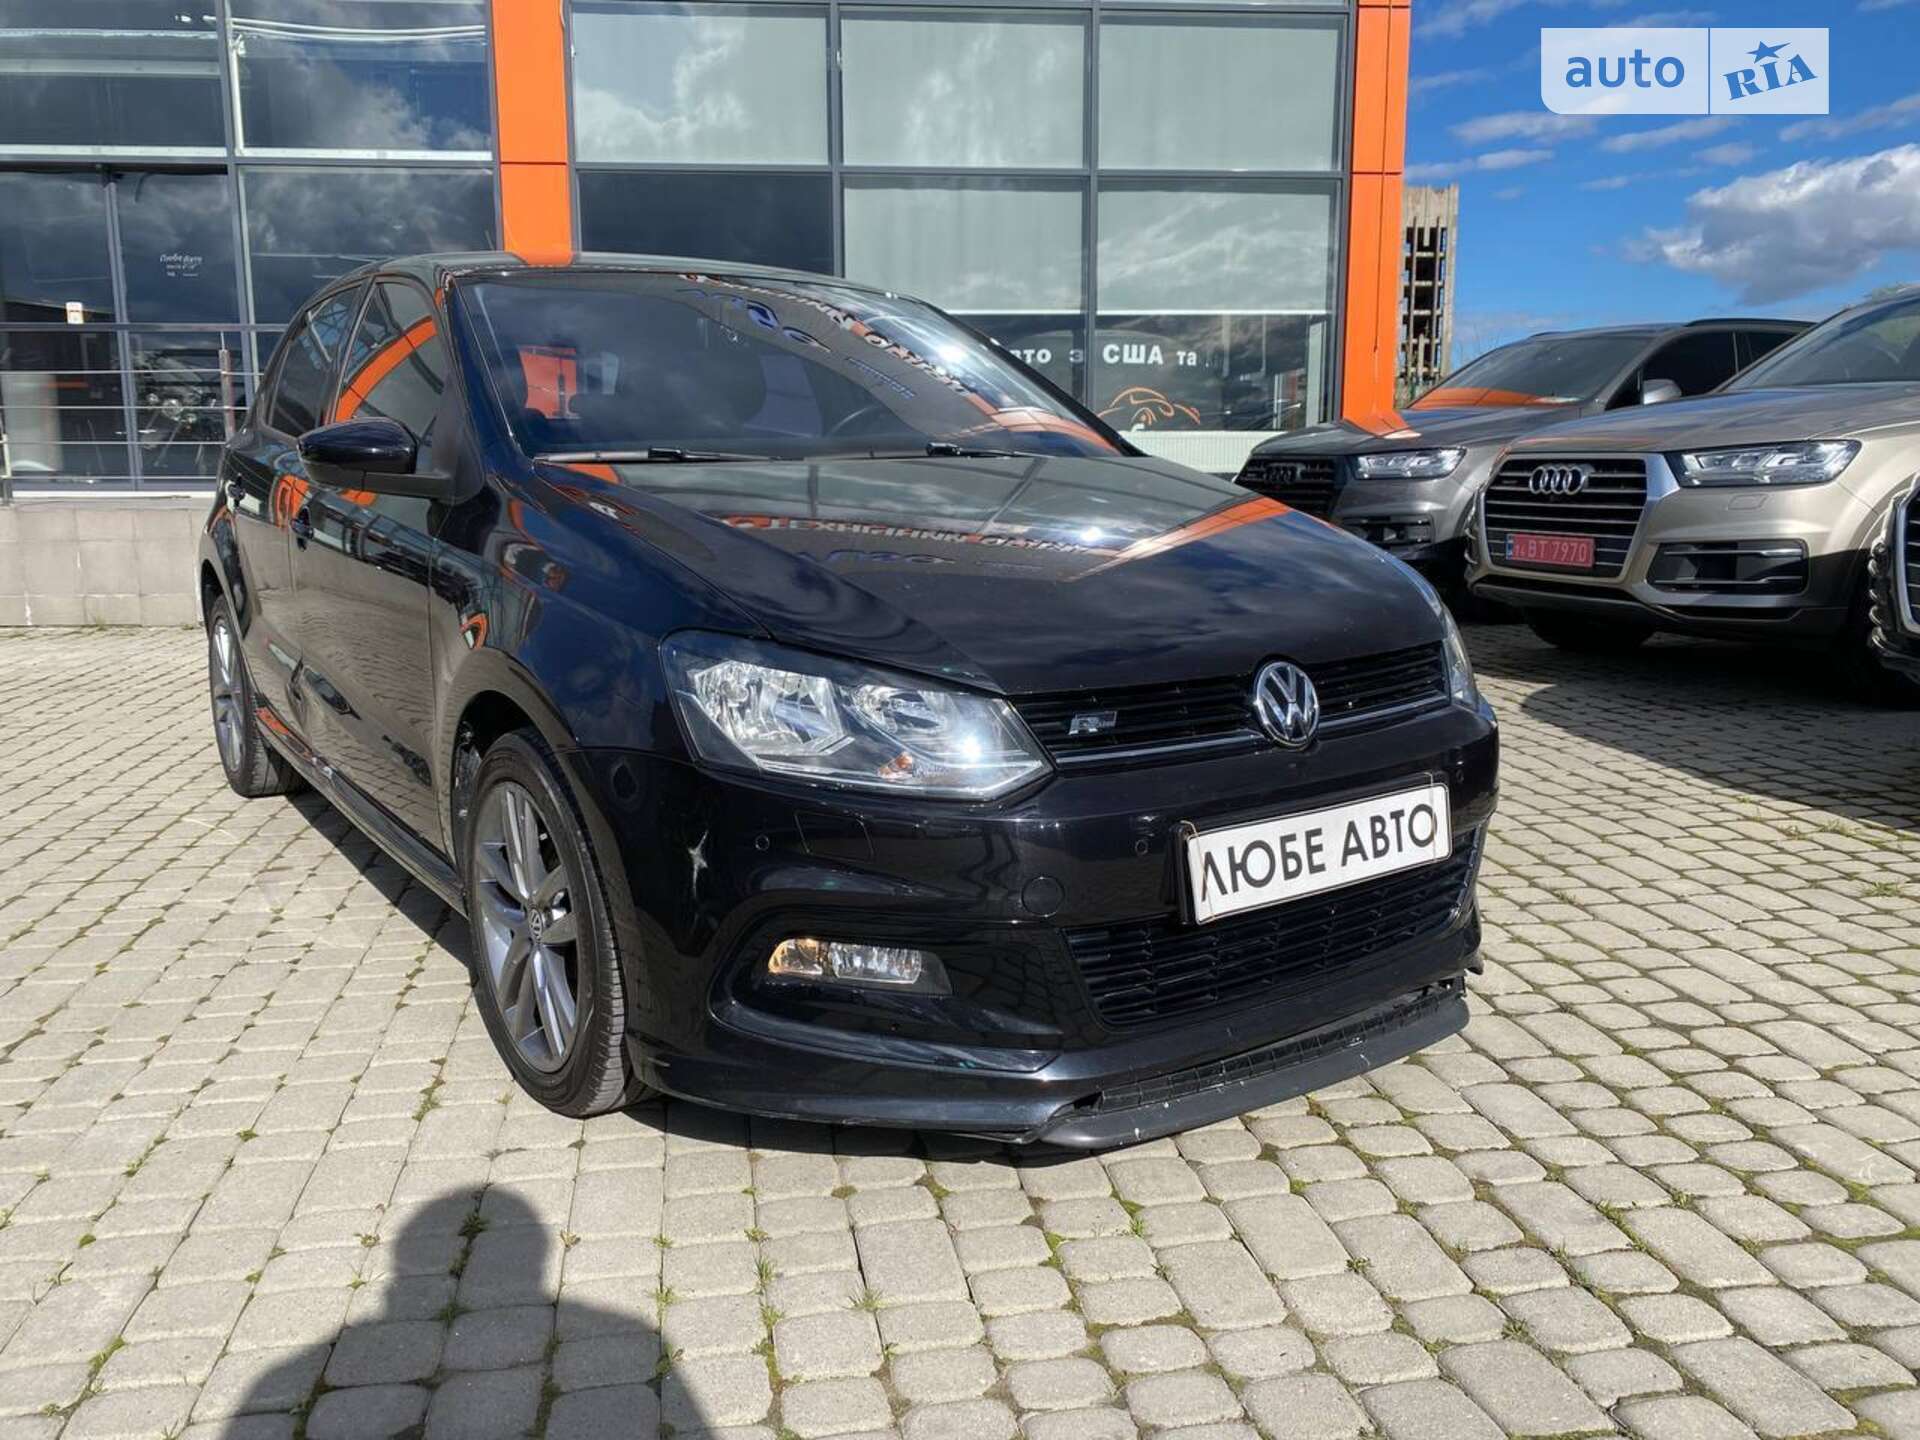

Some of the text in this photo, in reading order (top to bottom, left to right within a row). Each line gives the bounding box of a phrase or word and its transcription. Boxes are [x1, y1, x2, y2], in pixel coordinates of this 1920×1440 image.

[1102, 344, 1164, 364] США
[1175, 350, 1198, 367] та
[1551, 541, 1589, 562] 7970
[1201, 803, 1438, 902] ЛЮБЕ АВТО
